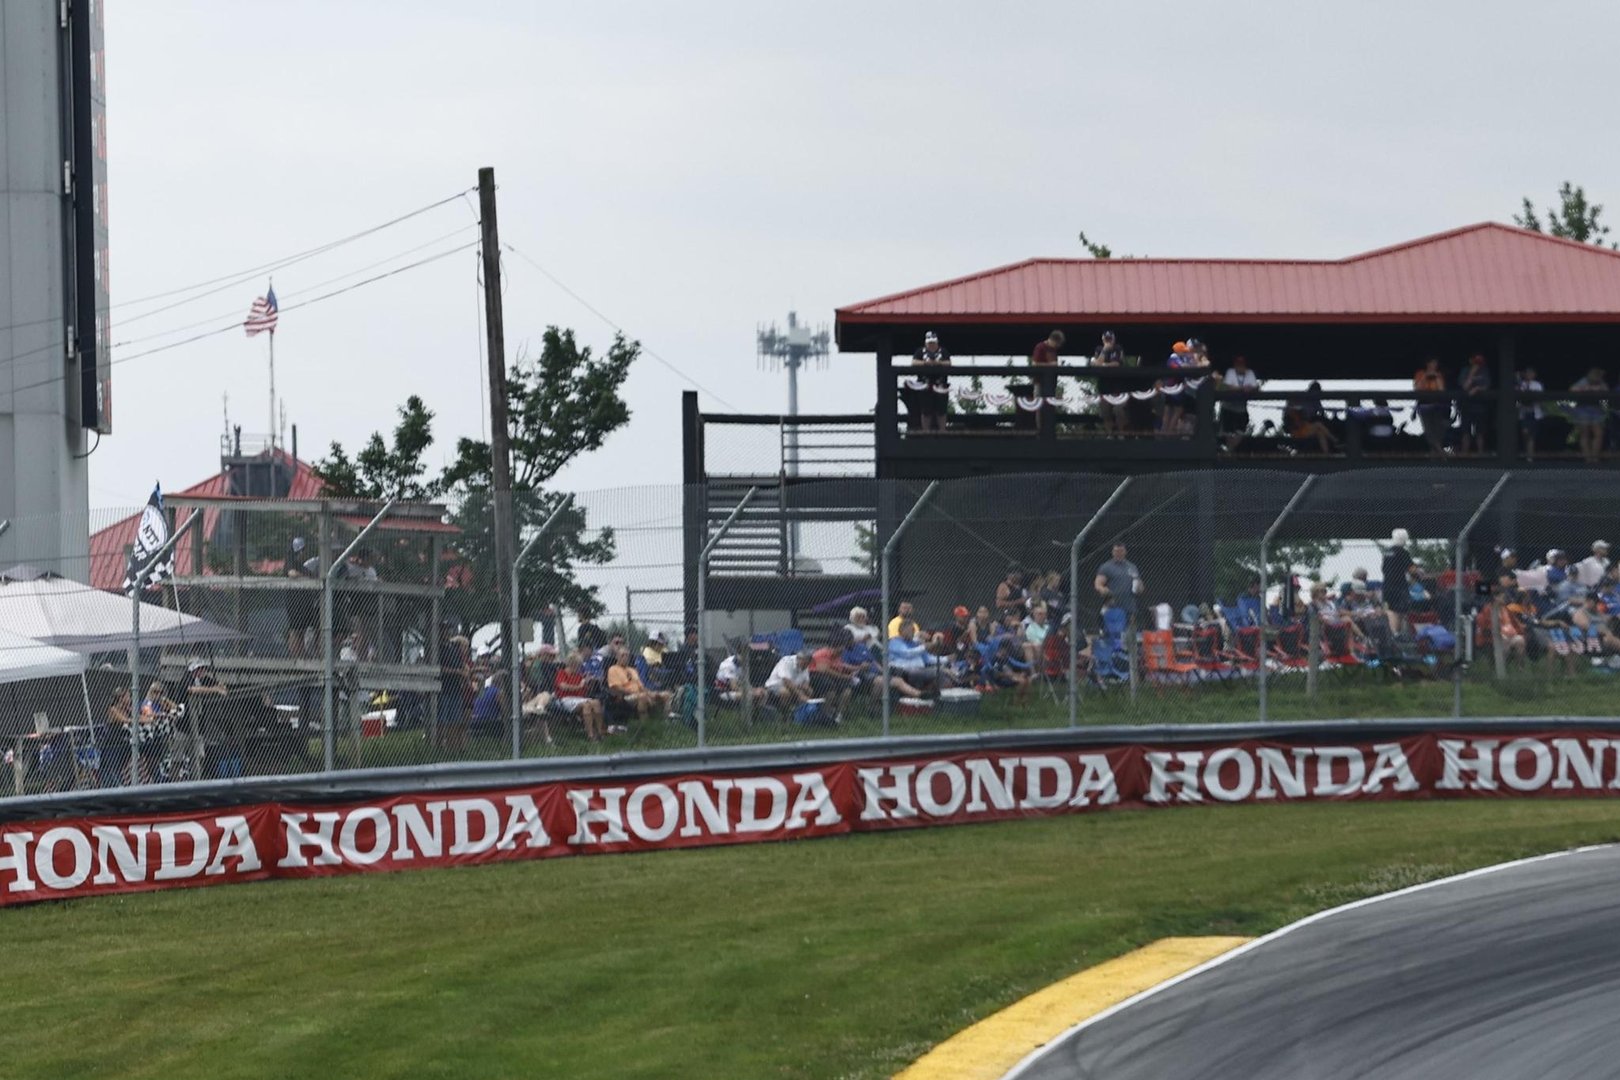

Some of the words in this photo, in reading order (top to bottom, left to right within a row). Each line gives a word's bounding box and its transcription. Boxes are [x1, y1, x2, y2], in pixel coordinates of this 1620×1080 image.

[857, 753, 1121, 821] HONDA
[1143, 742, 1420, 802] HONDA
[278, 794, 551, 869] HONDA
[567, 772, 842, 845] HONDA
